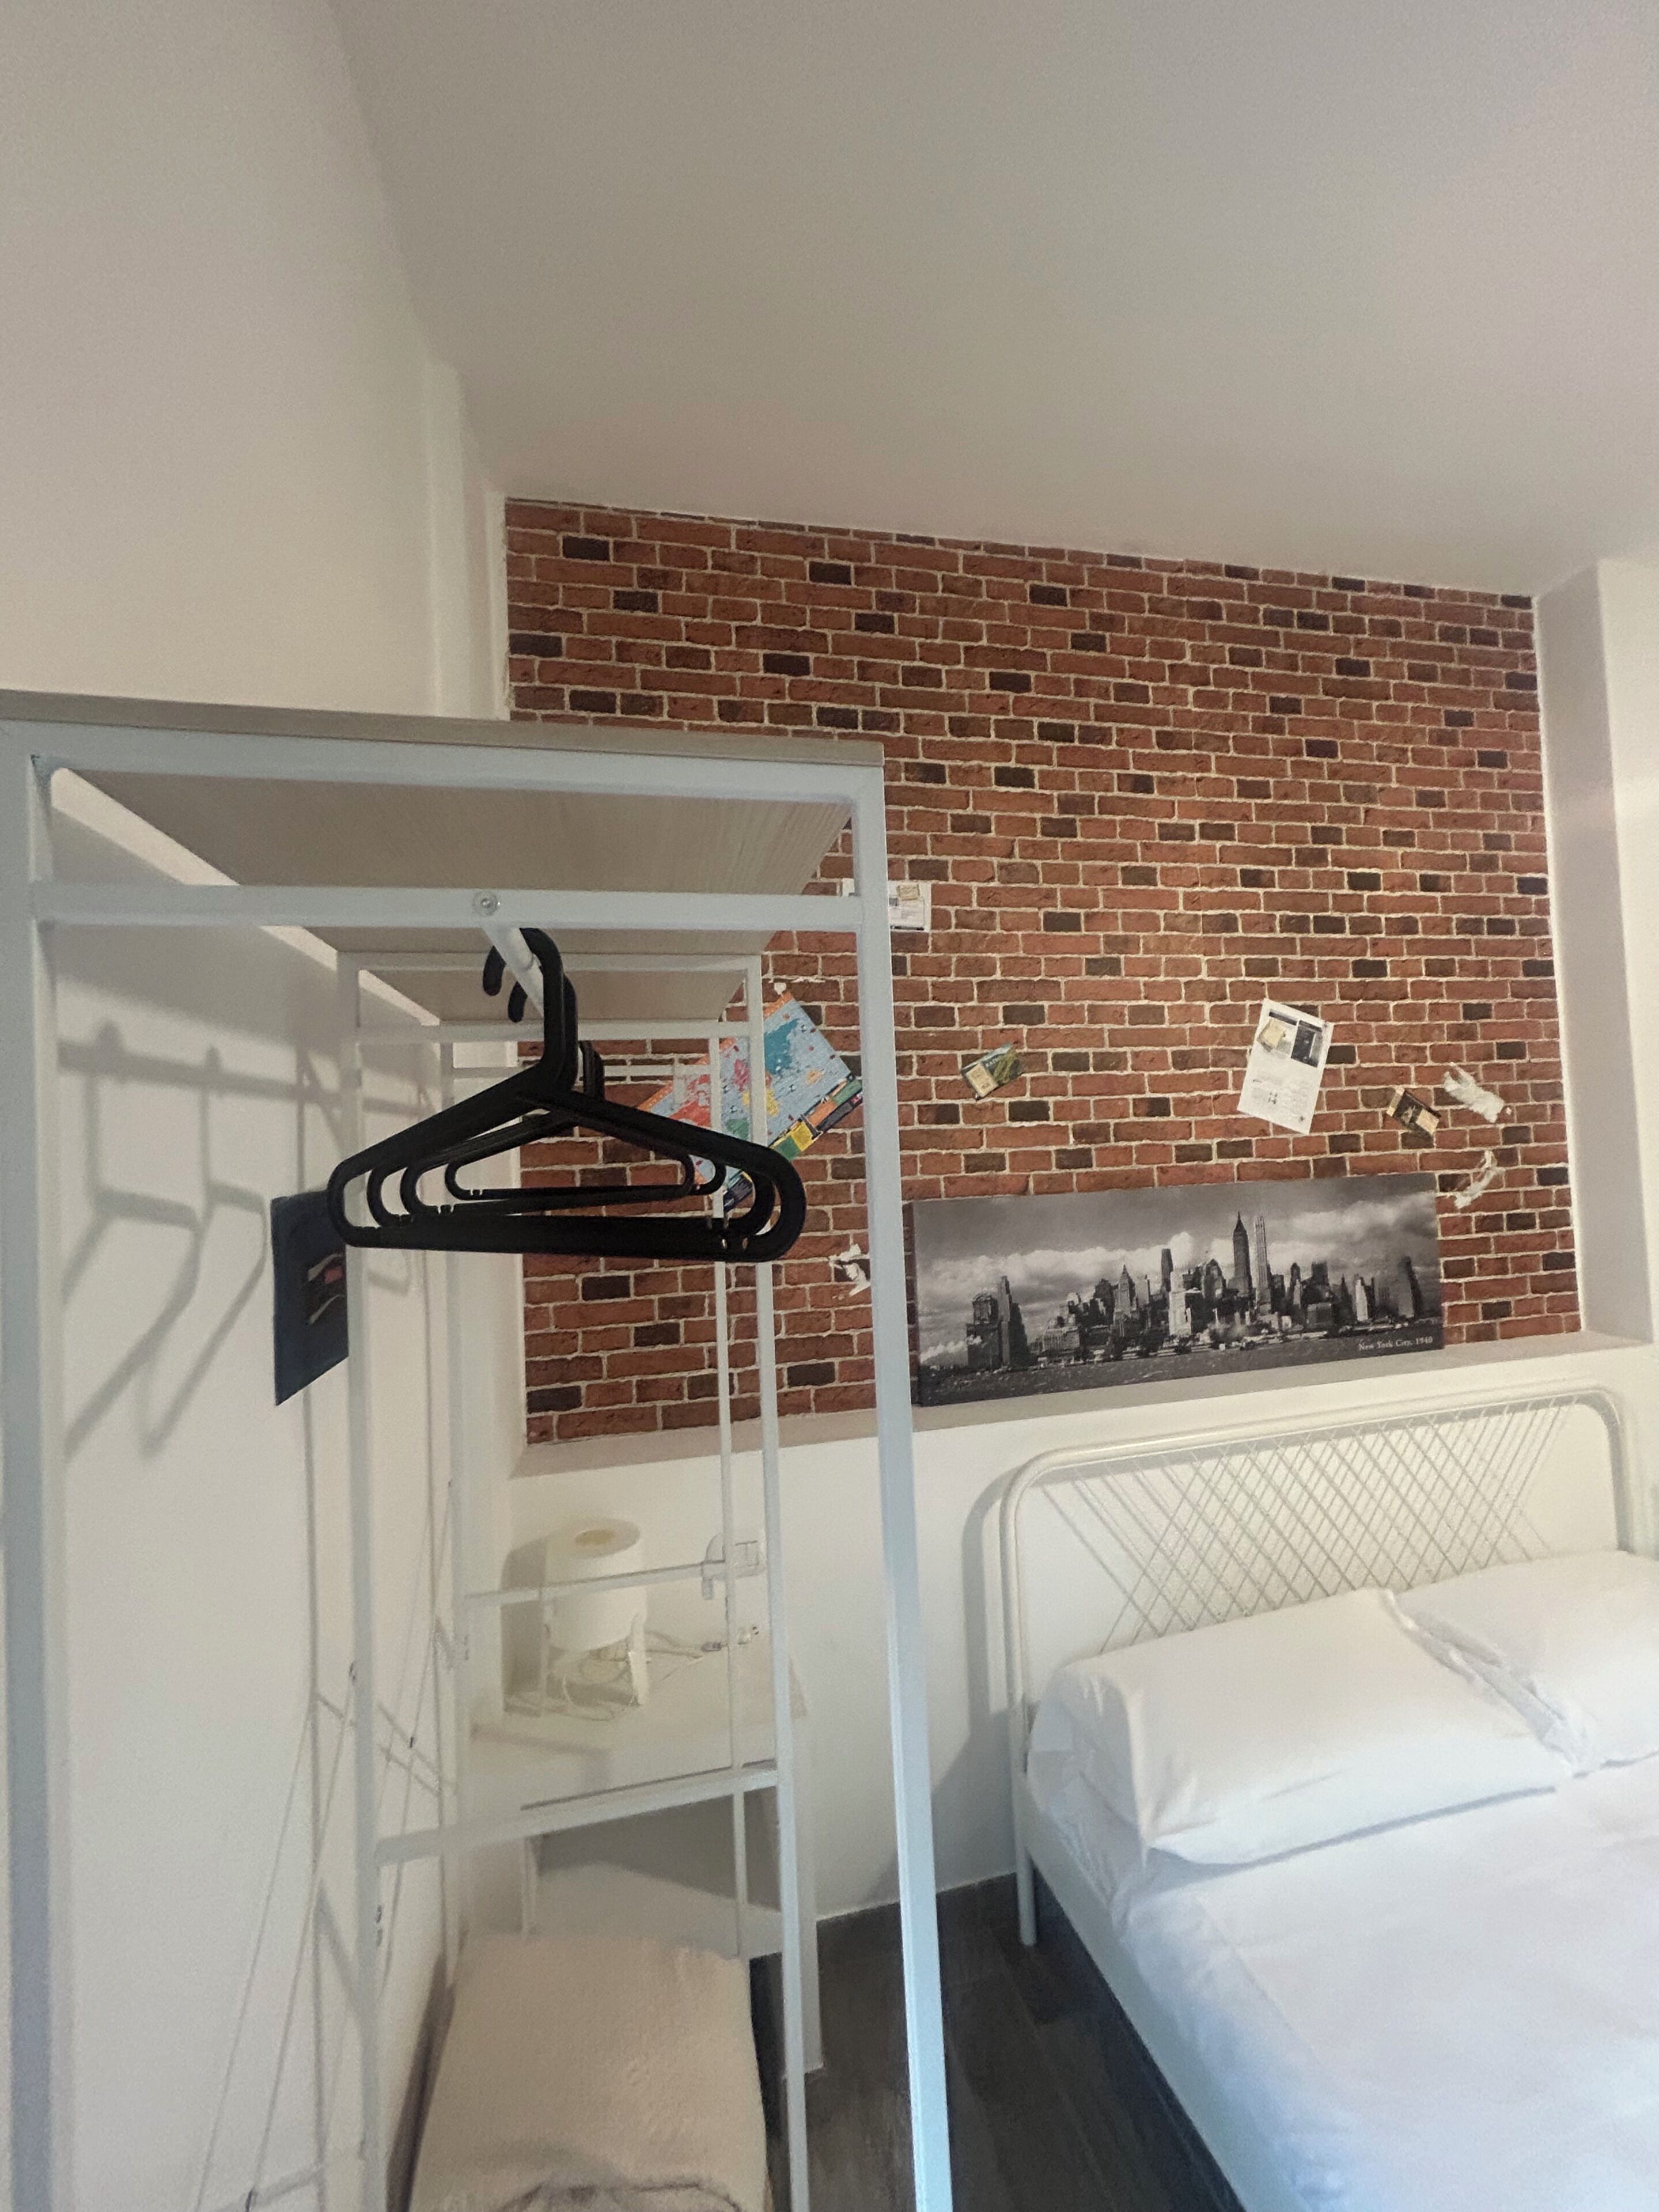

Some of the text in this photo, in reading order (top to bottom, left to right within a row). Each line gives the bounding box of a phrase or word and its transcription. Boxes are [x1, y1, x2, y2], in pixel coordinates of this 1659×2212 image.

[1358, 1343, 1374, 1351] New
[1377, 1340, 1393, 1349] York
[1415, 1336, 1433, 1345] 1940
